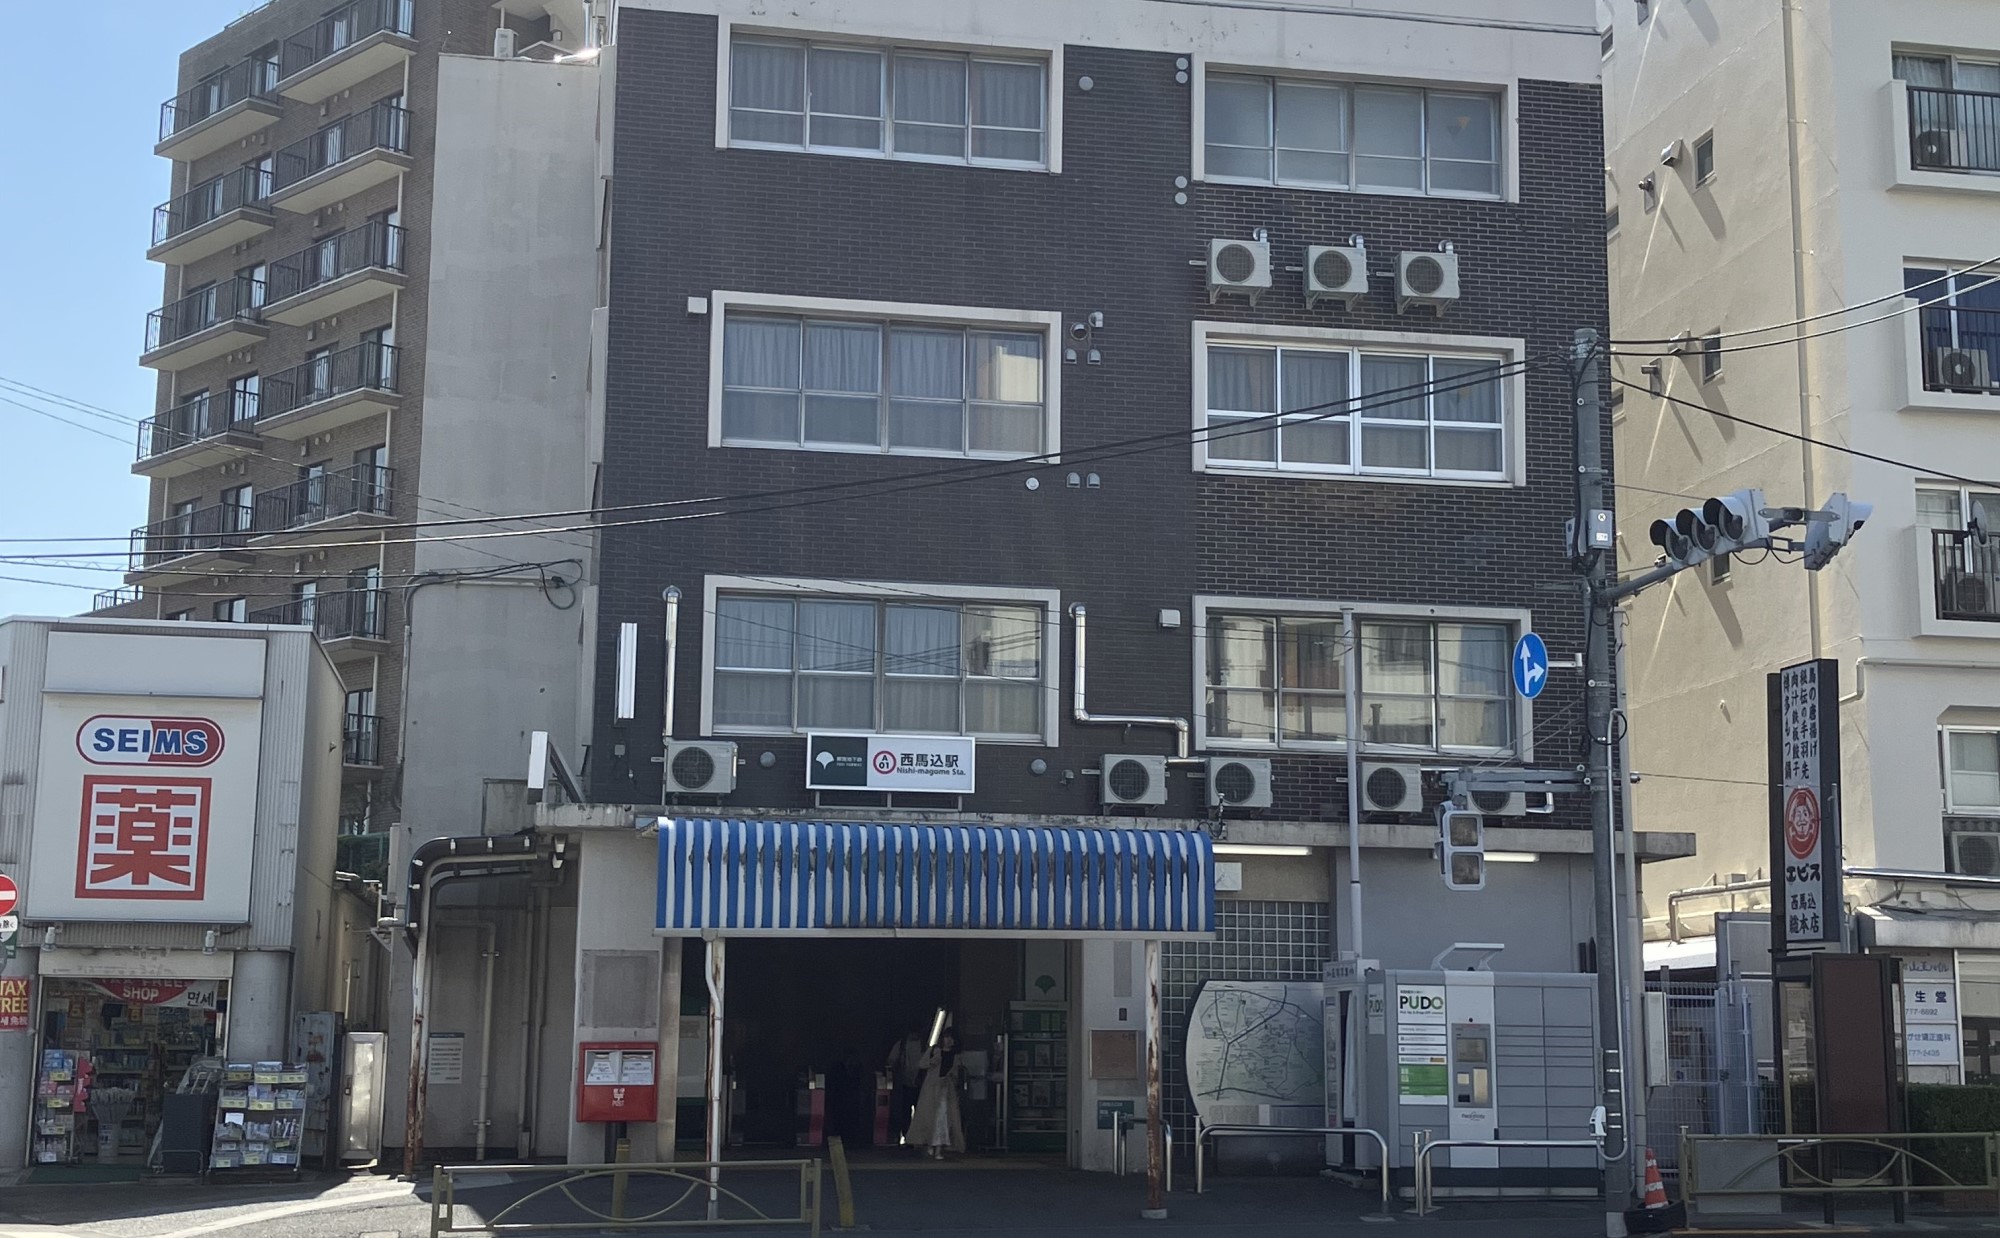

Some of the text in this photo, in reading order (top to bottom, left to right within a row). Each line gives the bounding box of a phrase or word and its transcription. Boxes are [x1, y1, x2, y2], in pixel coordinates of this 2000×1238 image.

[93, 728, 207, 756] SEIMS
[881, 754, 889, 762] A
[900, 753, 959, 768] 西馬込駅
[896, 767, 950, 776] Nishi-magome
[90, 788, 197, 887] 薬
[1786, 863, 1821, 883] エビス
[1790, 893, 1817, 911] 西馬込
[0, 919, 14, 929] 除く
[1789, 912, 1820, 935] 総本店
[0, 980, 27, 996] TAX
[122, 986, 159, 1001] SHOP
[0, 997, 28, 1013] REE
[187, 991, 214, 1007] 면세
[1399, 995, 1444, 1010] PUDO
